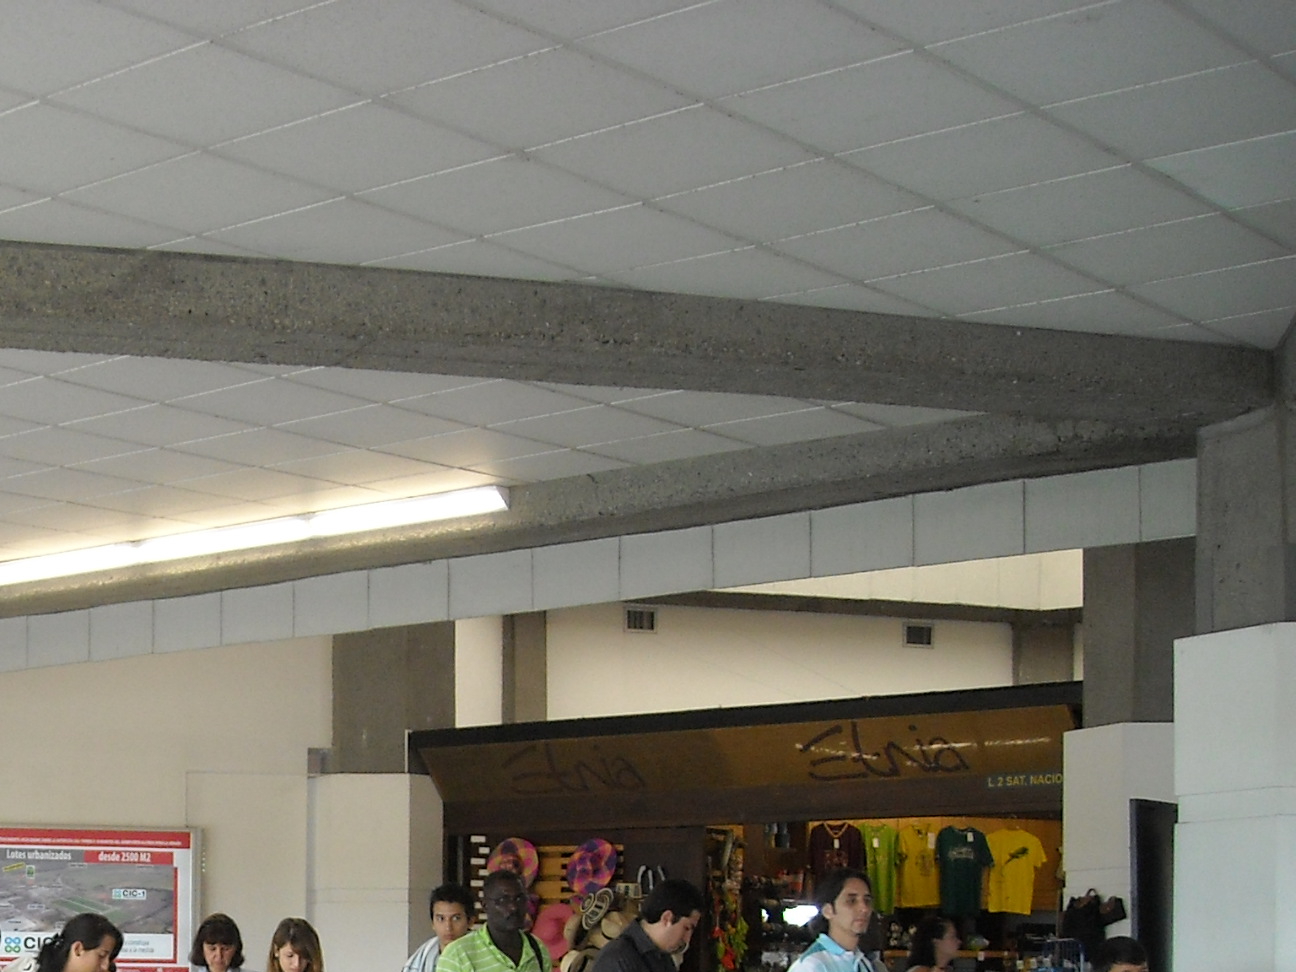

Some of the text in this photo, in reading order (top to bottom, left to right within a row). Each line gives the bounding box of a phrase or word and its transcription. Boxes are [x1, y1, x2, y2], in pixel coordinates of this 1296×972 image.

[798, 720, 970, 782] Etnia
[6, 849, 71, 861] Lotes urbanizados
[98, 851, 151, 862] desde 2500 M2
[122, 889, 145, 898] CIC-1
